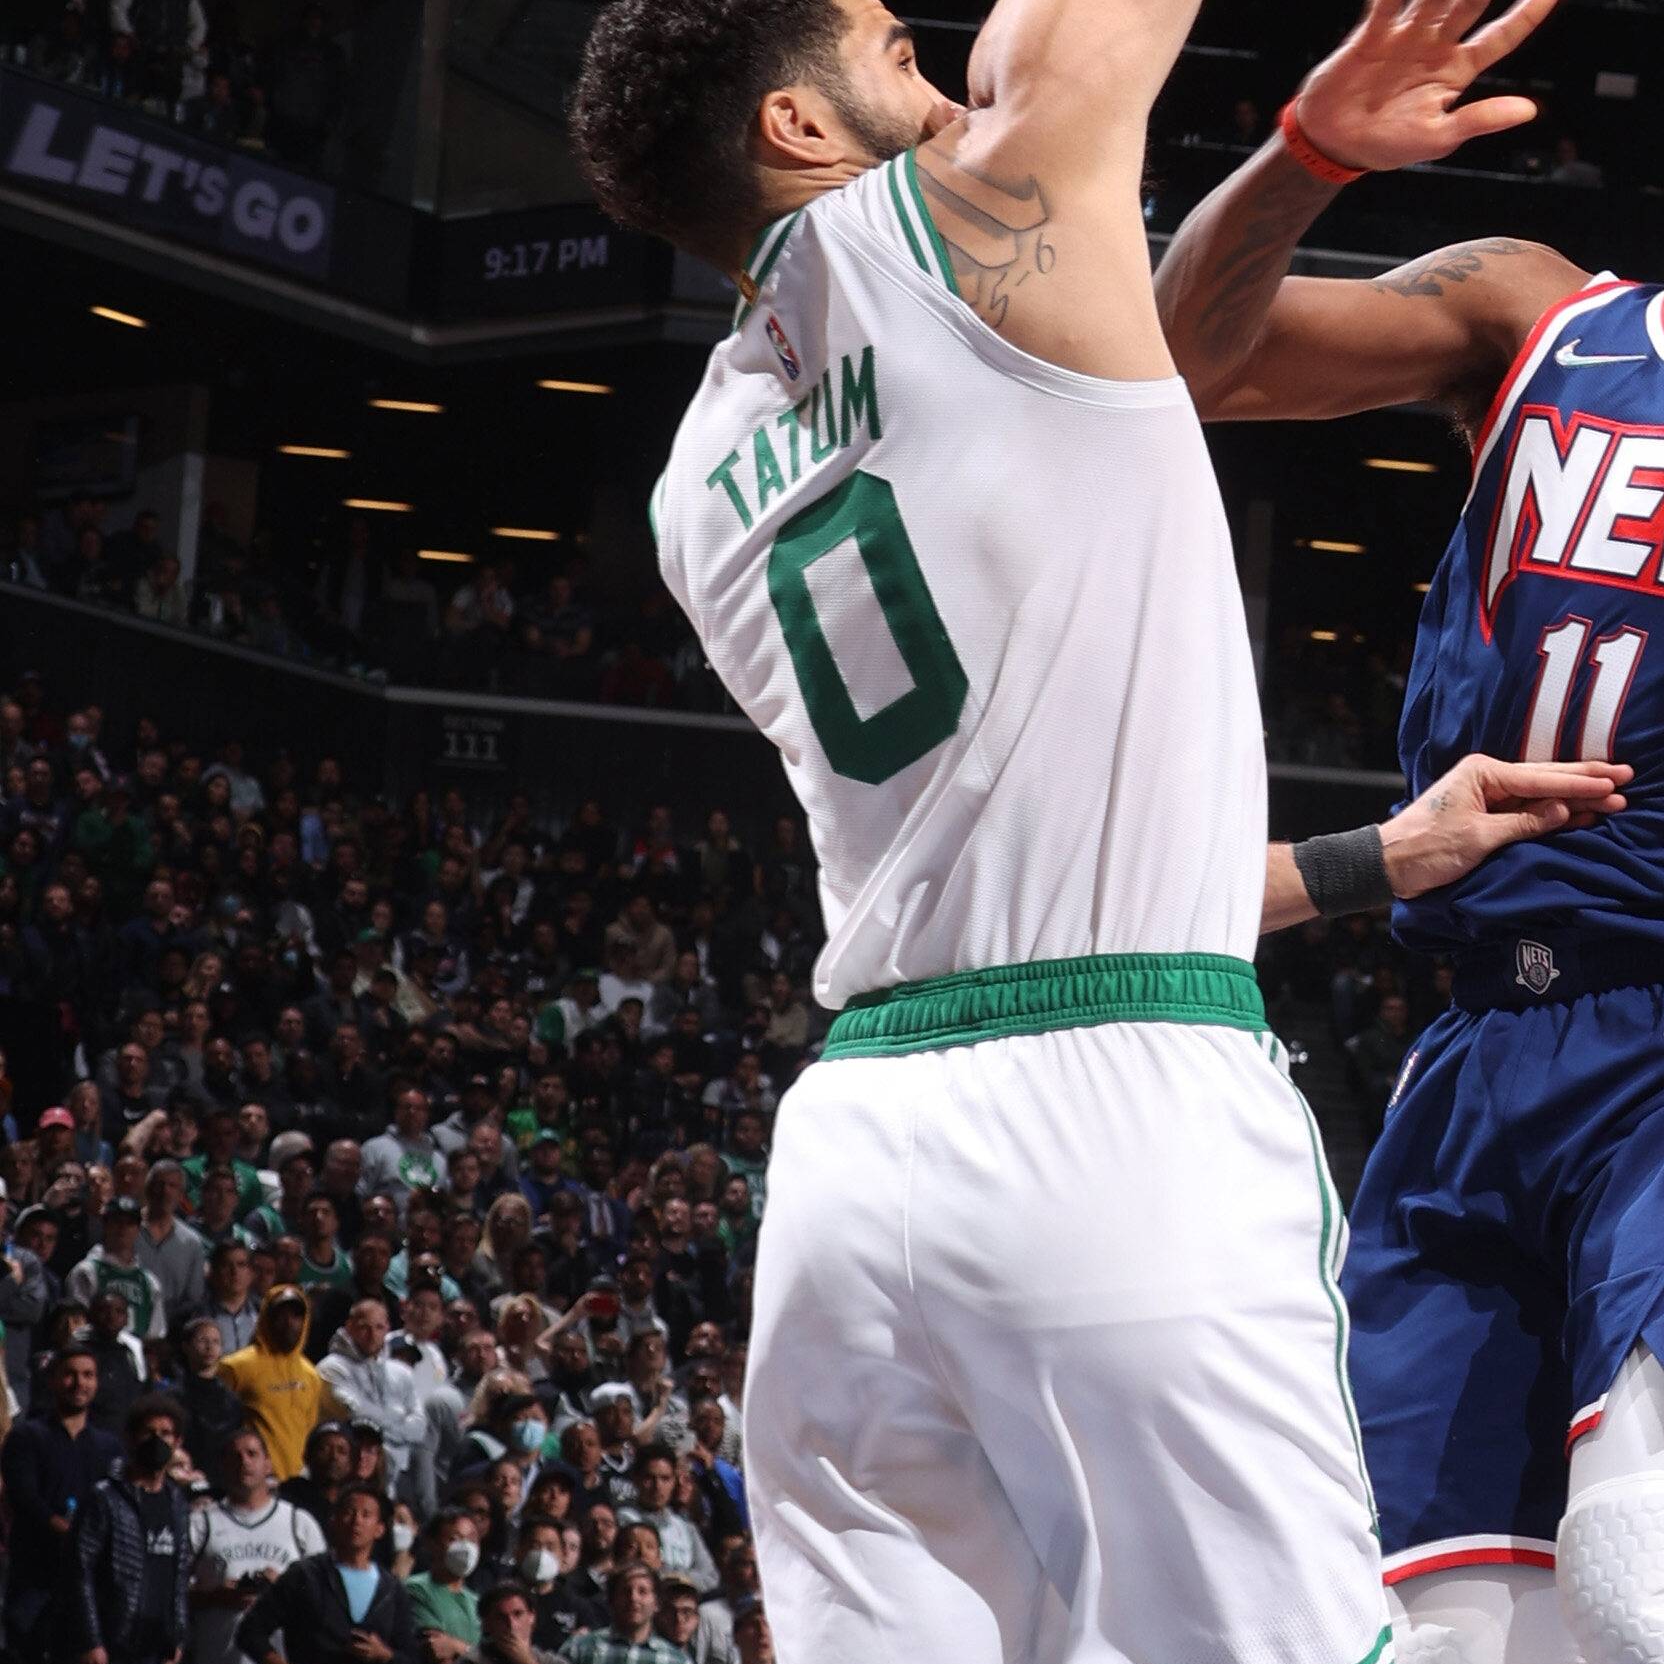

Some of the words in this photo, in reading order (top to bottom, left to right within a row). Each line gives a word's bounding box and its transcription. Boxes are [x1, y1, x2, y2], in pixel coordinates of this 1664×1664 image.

[5, 102, 230, 217] LET'S
[231, 180, 326, 254] GO
[484, 241, 550, 280] 9:17
[557, 236, 610, 272] PM
[706, 345, 882, 532] TATUM
[768, 469, 970, 786] 0
[1518, 614, 1650, 764] 11
